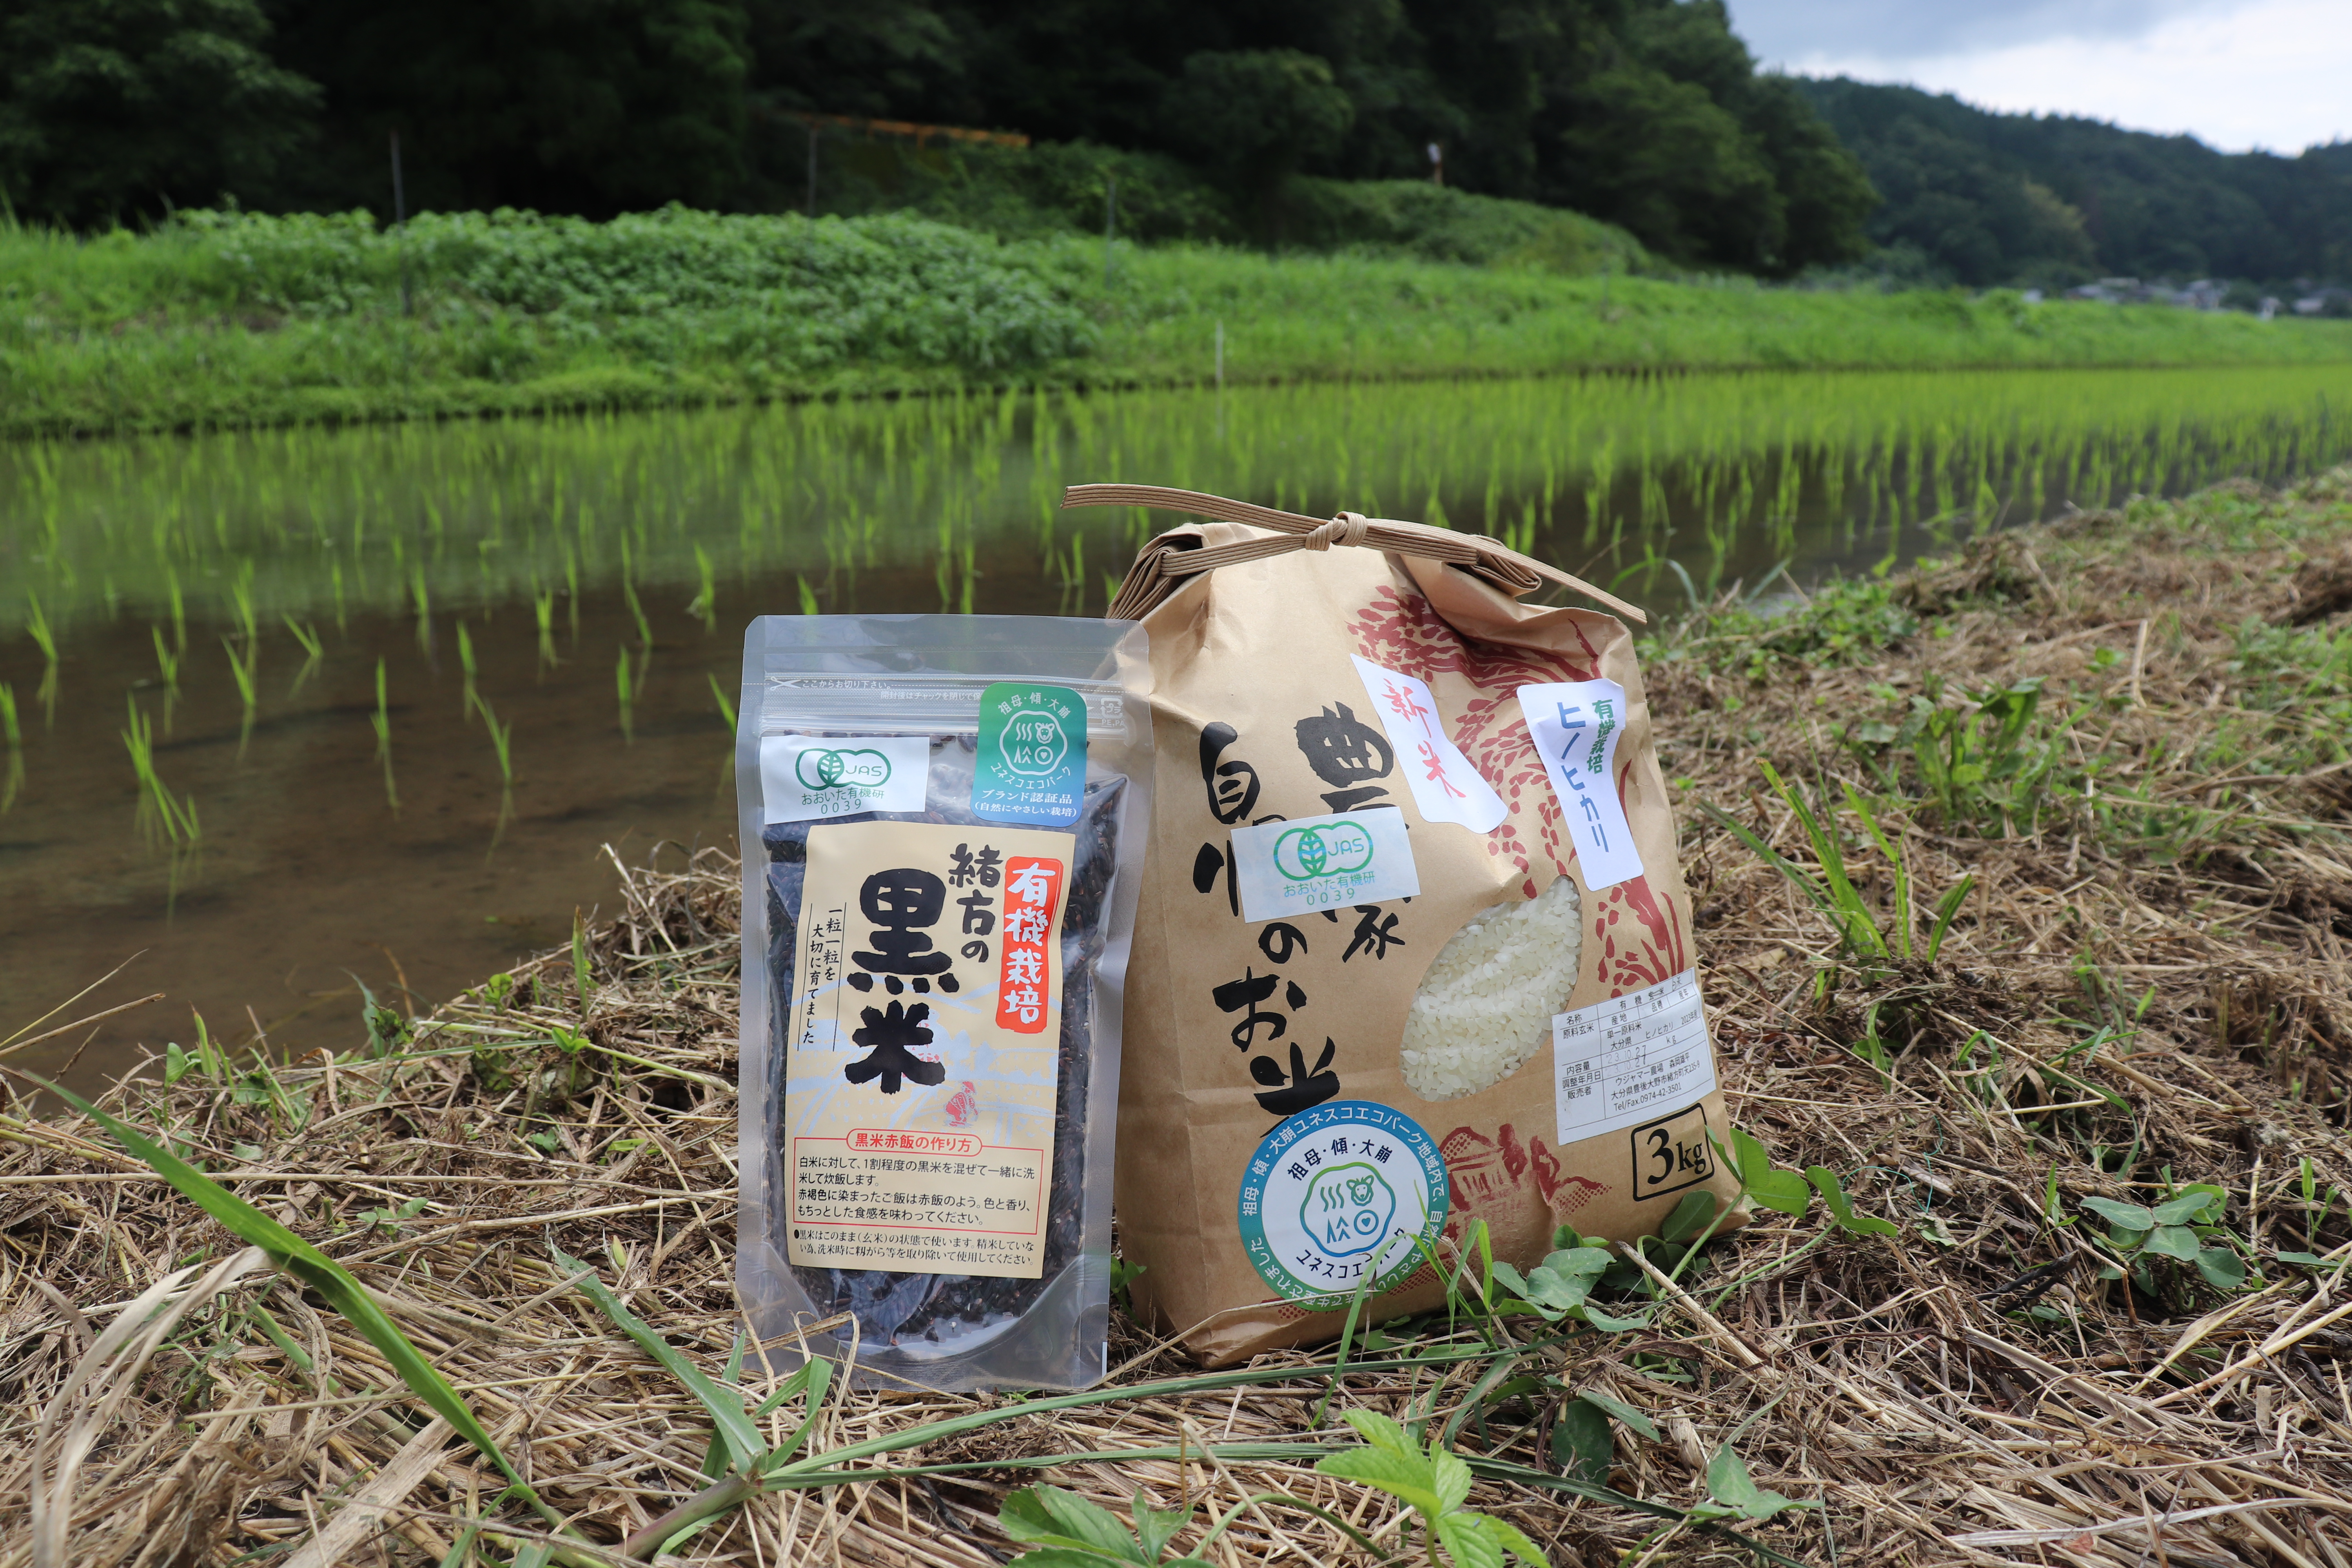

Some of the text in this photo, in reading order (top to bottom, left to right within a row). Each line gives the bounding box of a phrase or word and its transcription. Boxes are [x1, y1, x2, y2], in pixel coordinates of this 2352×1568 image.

[802, 680, 891, 690] ここからお切り下さい。
[880, 691, 982, 701] 開封後はチャックを閉じて保
[1381, 678, 1466, 799] 新米
[1586, 699, 1616, 774] 有機栽培
[845, 765, 882, 777] JAS
[990, 762, 1071, 789] ユネスコエコパーク
[1557, 701, 1610, 853] ヒノヒカリ
[801, 787, 885, 806] おおいた有機研
[981, 789, 1073, 804] ブランド認証品
[821, 799, 862, 814] 0039
[1327, 838, 1365, 857] JAS
[1283, 871, 1376, 898] おおいた有機研
[948, 843, 1004, 963] 緒方の
[1307, 889, 1355, 905] 0039
[823, 909, 843, 980] 一粒一粒を
[1004, 862, 1056, 1024] 有機栽培
[803, 924, 825, 1044] 大切に育てました
[845, 868, 960, 1095] 黒米
[1651, 999, 1664, 1013] 品種
[1566, 1013, 1583, 1025] 名称
[1611, 1012, 1628, 1025] 産地
[1563, 1022, 1595, 1039] 原料玄米
[1607, 1021, 1642, 1039] 単一原料米
[1610, 1036, 1632, 1051] 大分県
[1645, 1021, 1673, 1039] ヒノヒカリ
[1566, 1061, 1590, 1076] 内容量
[1615, 1063, 1664, 1086] ウジャマー農場
[1562, 1071, 1601, 1089] 調整年月日
[1567, 1085, 1592, 1100] 販売者
[855, 1133, 972, 1153] 黒米赤飯の作り方
[800, 1156, 1035, 1180] 白米に対して、1割程度の黒米を混ぜて一緒に洗
[799, 1172, 879, 1187] 米して炊飯します。
[798, 1189, 1030, 1212] 赤褐色に染まったご飯は赤飯のよう。色と香り、
[798, 1205, 983, 1225] もちっとした食感を味わってください。
